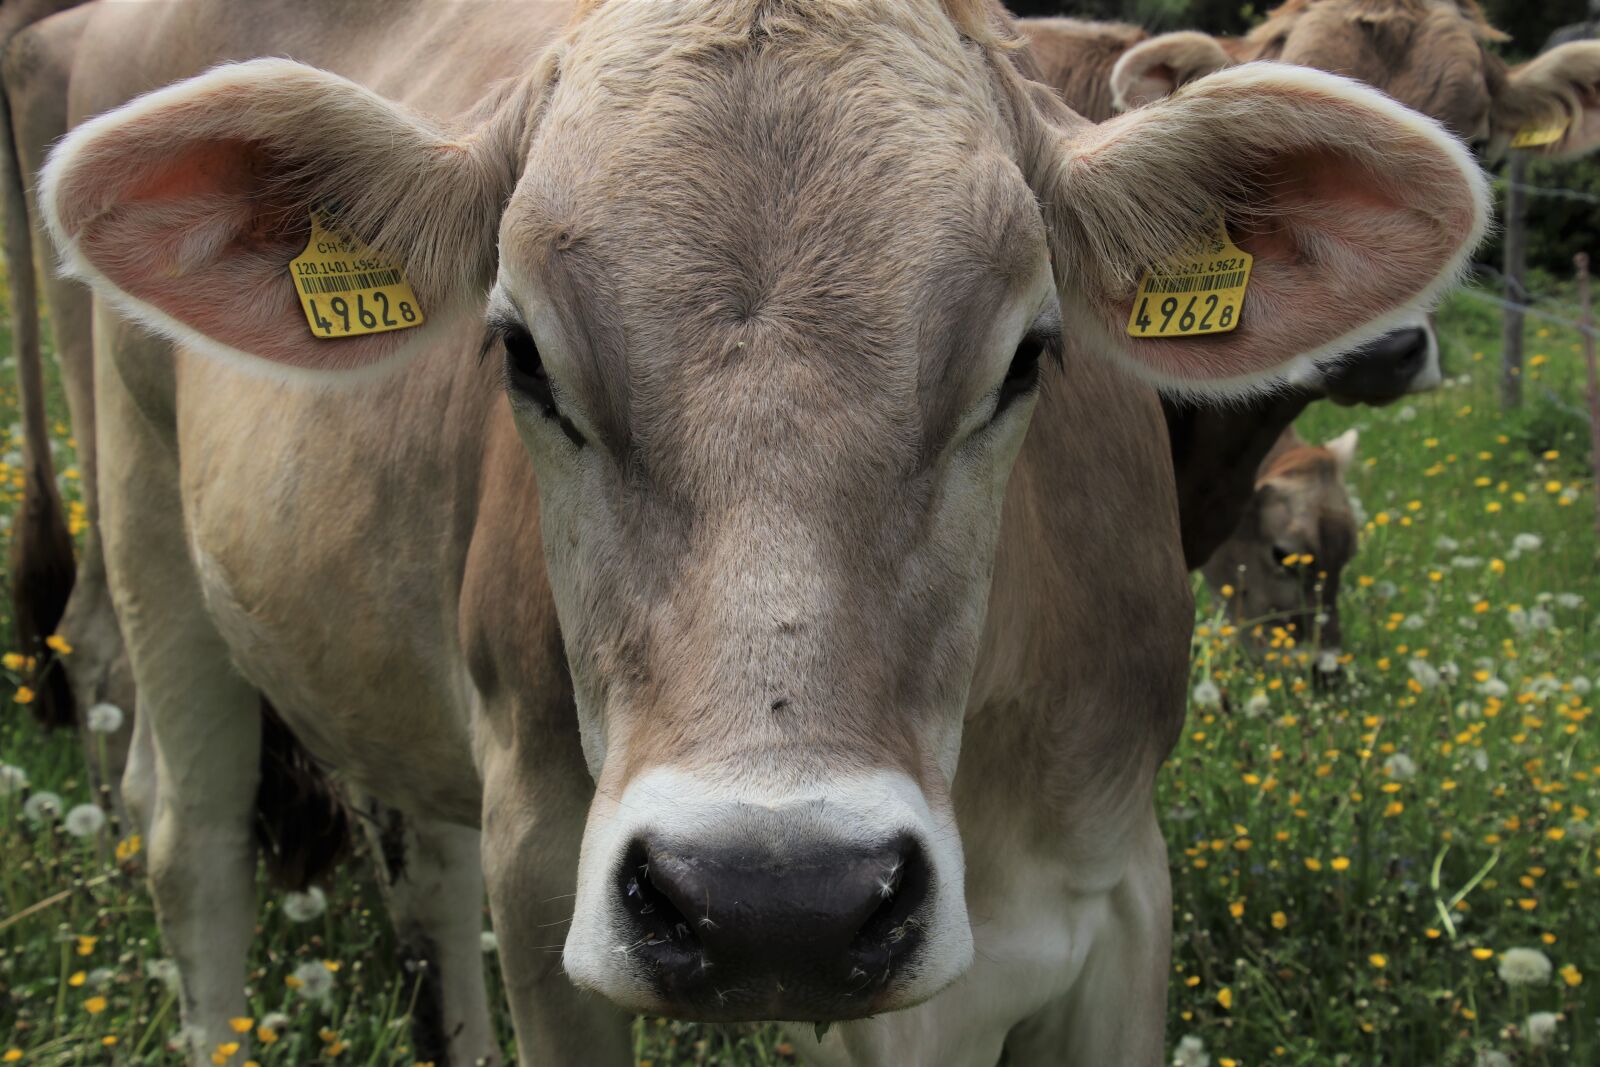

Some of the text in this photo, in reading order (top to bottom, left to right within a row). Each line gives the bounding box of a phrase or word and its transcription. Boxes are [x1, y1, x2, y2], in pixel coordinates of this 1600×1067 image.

[296, 258, 392, 275] 120.1401.4962.
[309, 292, 416, 334] 49628
[1135, 294, 1234, 333] 49628
